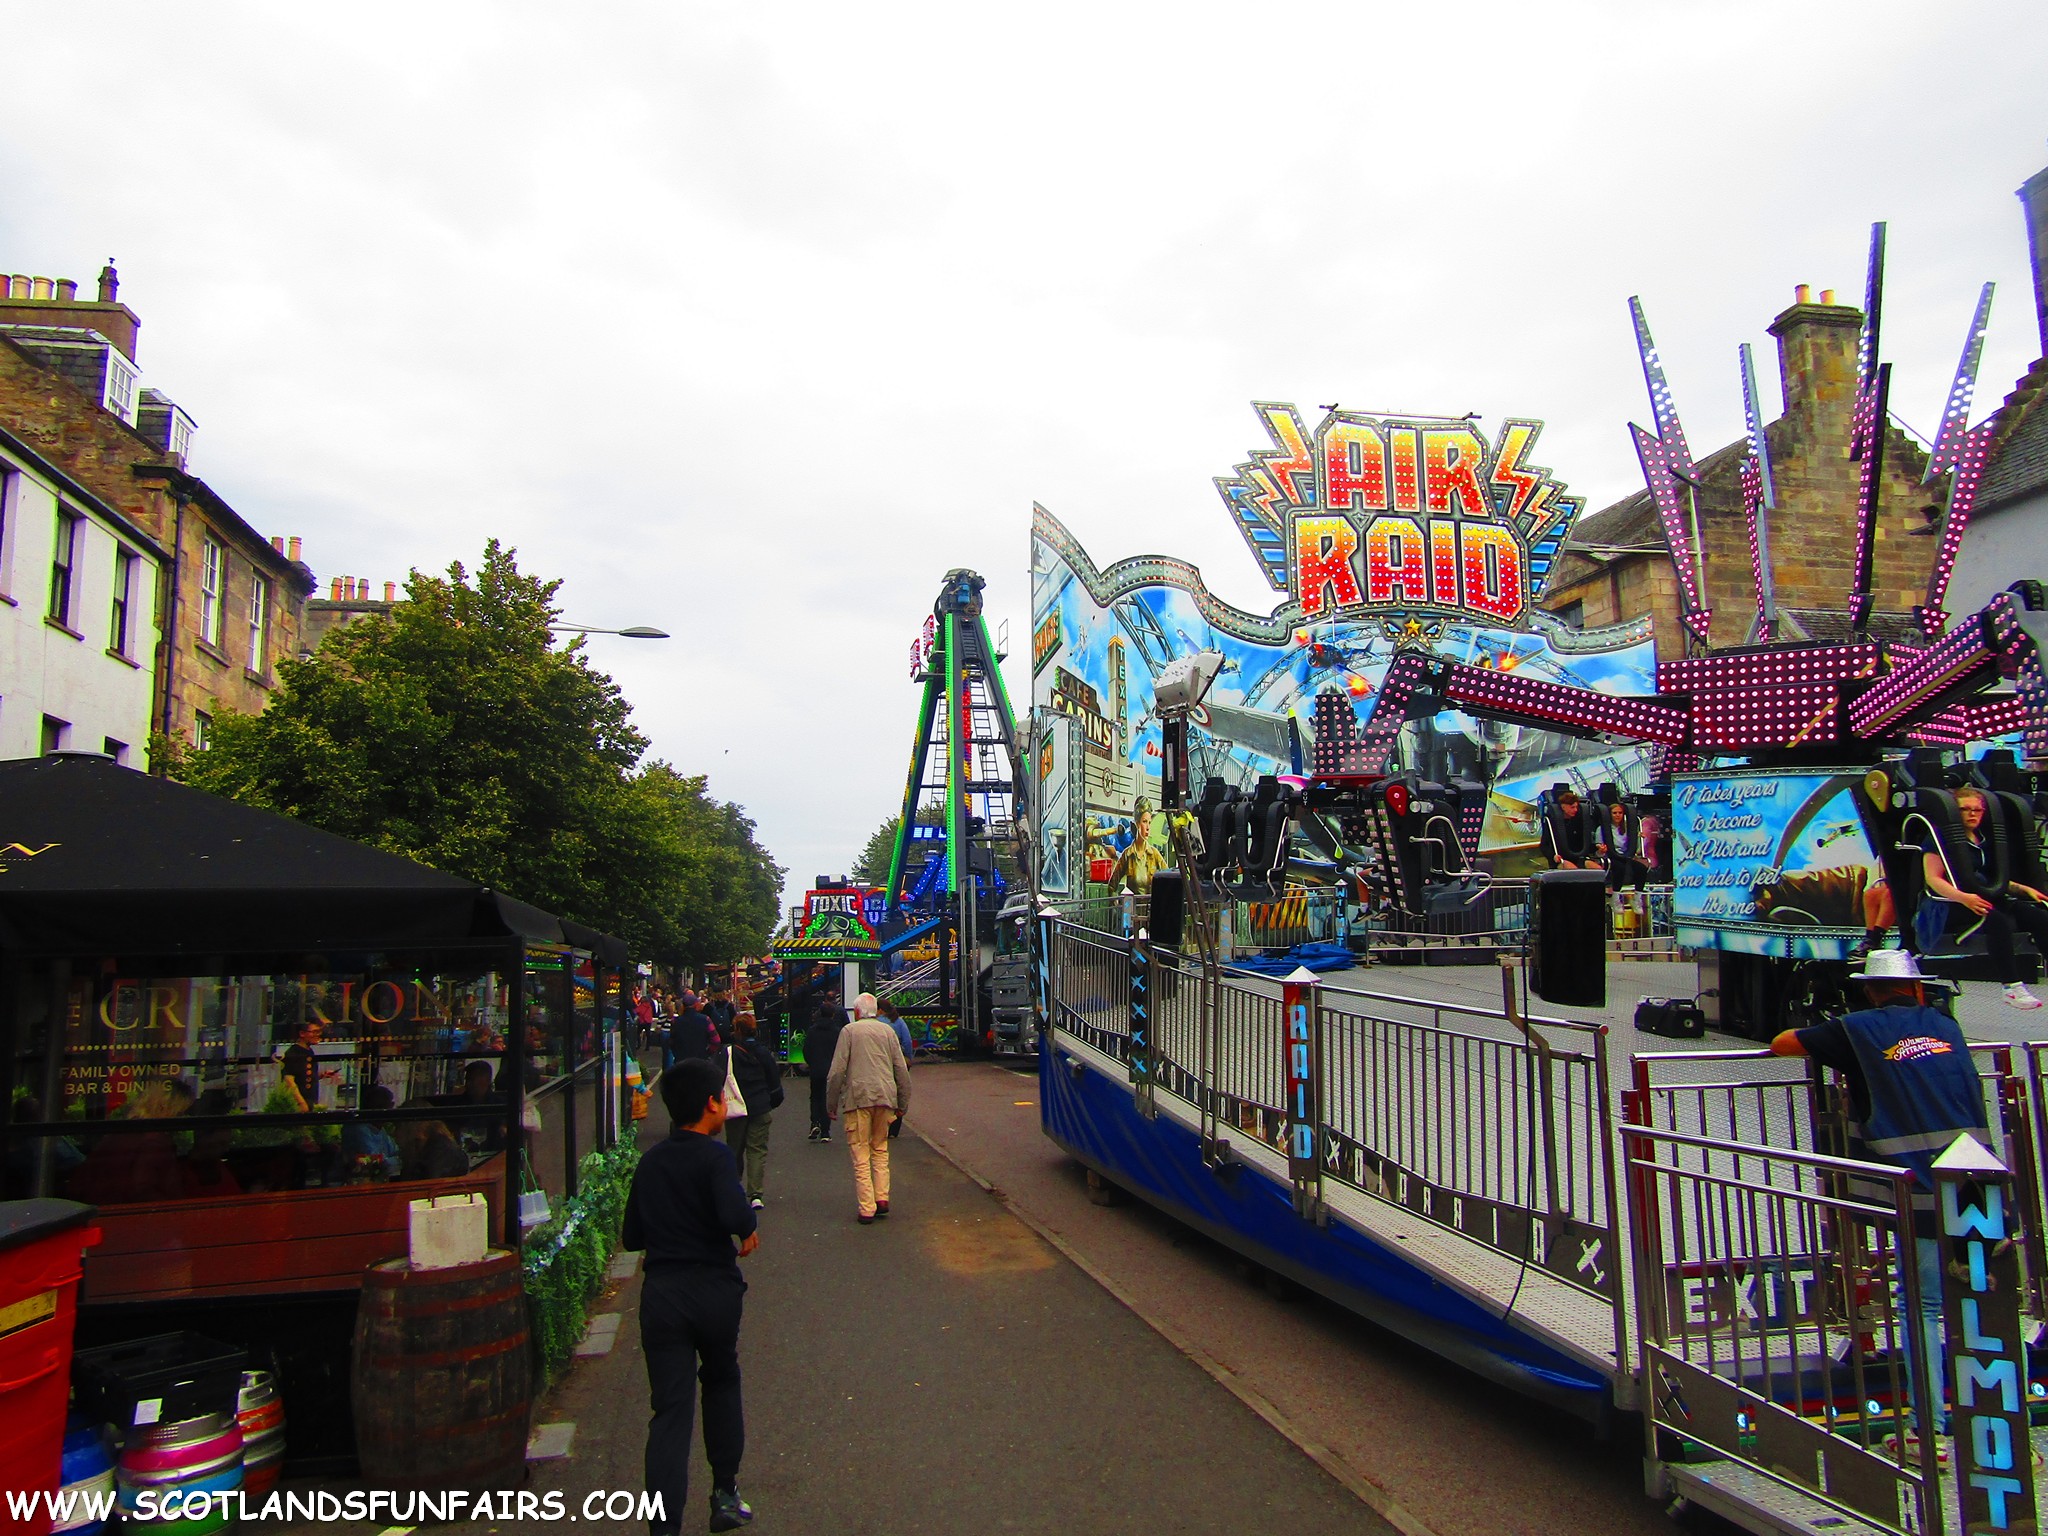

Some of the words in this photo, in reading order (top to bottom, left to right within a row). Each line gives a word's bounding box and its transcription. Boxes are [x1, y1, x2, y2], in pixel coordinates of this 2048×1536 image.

[1324, 420, 1489, 518] AIR
[1295, 516, 1522, 623] RAID
[1060, 671, 1090, 706] CAFE
[1117, 646, 1128, 758] TEXACO
[1677, 784, 1697, 808] It
[1698, 783, 1734, 804] takes
[1730, 781, 1778, 809] years
[1691, 814, 1705, 833] to
[1707, 812, 1761, 830] become
[1685, 847, 1696, 860] a
[1700, 837, 1740, 860] Pilot
[1738, 835, 1773, 857] and
[1680, 875, 1703, 888] one
[1705, 867, 1735, 887] ride
[1735, 867, 1750, 886] to
[1749, 865, 1783, 893] feel
[810, 895, 858, 916] TOXIC
[1700, 896, 1728, 915] like
[1729, 900, 1756, 915] one
[99, 979, 458, 1031] CRITERION
[1893, 1042, 1944, 1061] ATTRACTIONS
[60, 1066, 117, 1080] FAMILY
[119, 1063, 181, 1077] OWNED
[1289, 1004, 1313, 1160] RAID
[64, 1081, 98, 1095] BAR
[101, 1082, 112, 1094] &
[1684, 1269, 1815, 1325] EXIT
[1940, 1180, 2022, 1536] WILMOT
